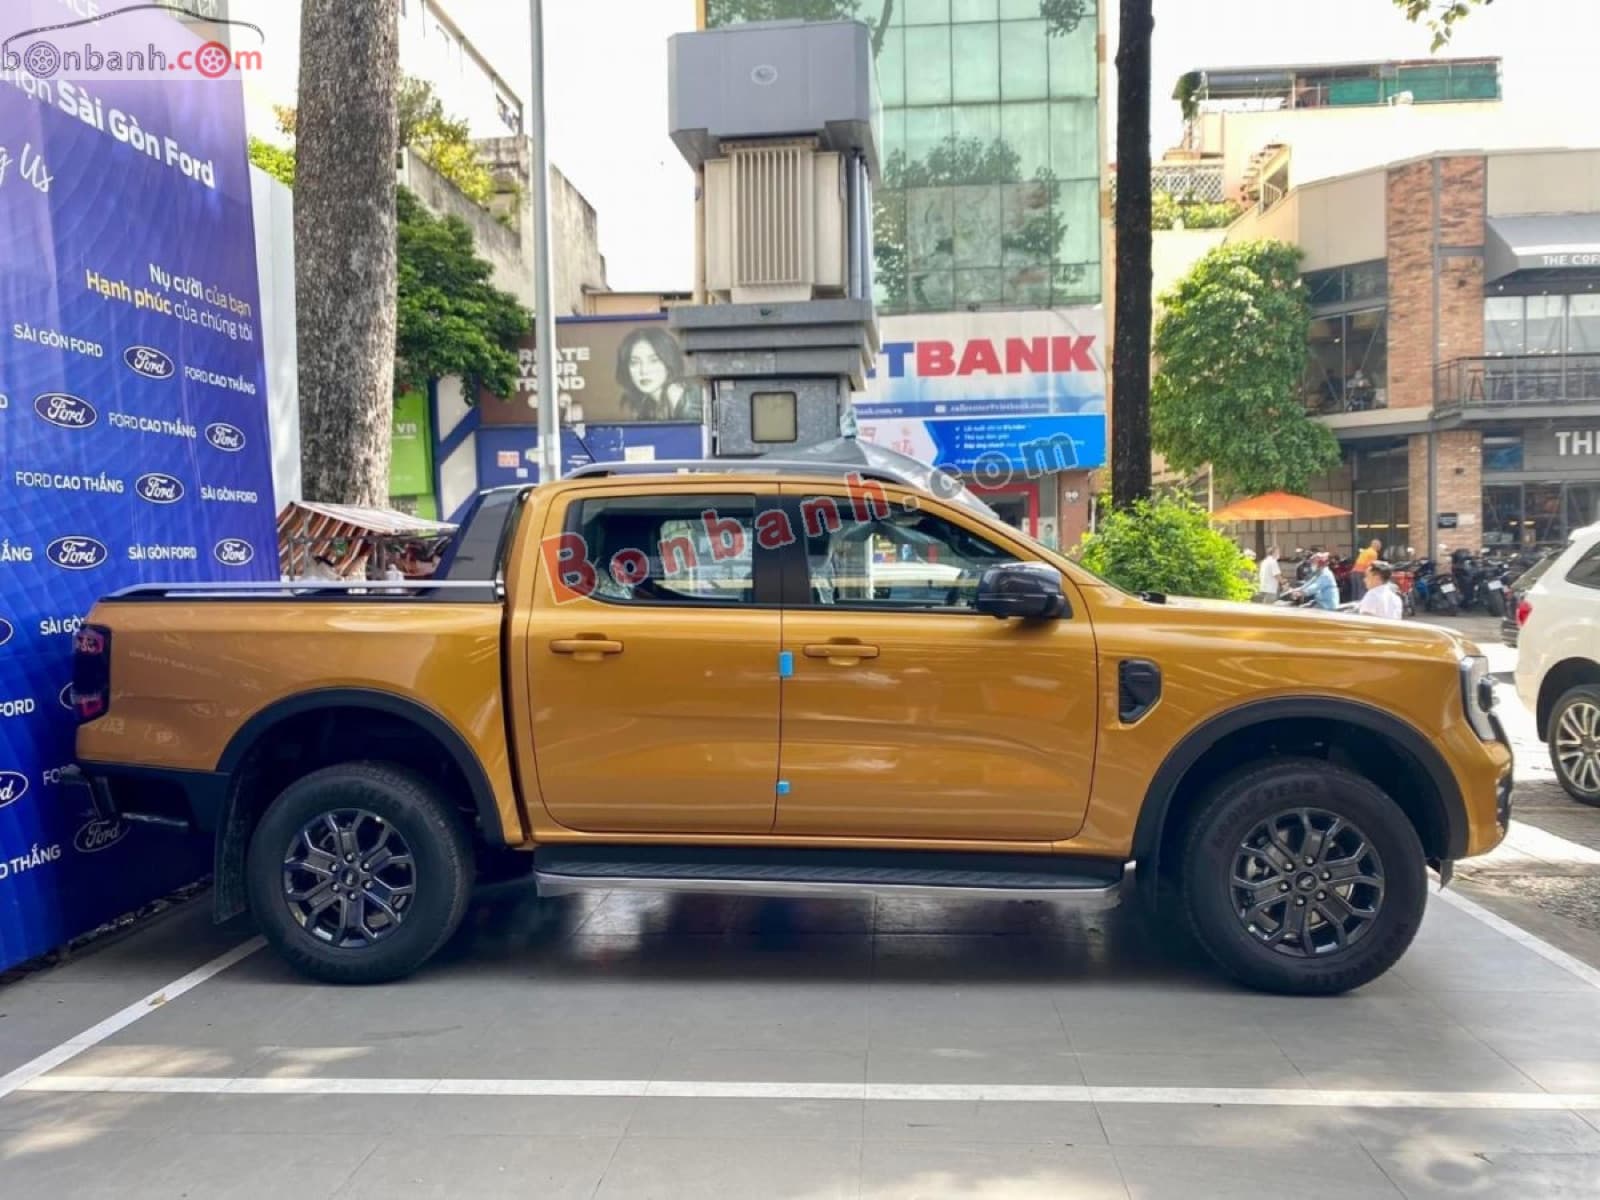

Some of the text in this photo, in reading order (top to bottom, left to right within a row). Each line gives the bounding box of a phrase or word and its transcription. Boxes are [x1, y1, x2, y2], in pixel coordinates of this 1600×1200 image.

[57, 79, 104, 131] Sài
[108, 108, 161, 161] Gòn
[164, 136, 216, 189] Ford
[1543, 255, 1568, 265] THE
[149, 263, 171, 292] Nụ
[205, 285, 230, 306] của
[86, 269, 253, 342] Hạnh phúc của chúng tôi
[14, 321, 104, 358] SÀI GÒN FORD
[134, 349, 167, 375] Ford
[866, 335, 1097, 379] TBANK
[184, 366, 208, 384] FORD
[208, 373, 228, 389] CAO
[47, 396, 86, 425] Ford
[109, 413, 137, 430] FORD
[139, 416, 162, 434] CAO
[213, 426, 239, 448] Ford
[16, 472, 52, 488] FORD
[54, 474, 81, 490] CAO
[144, 477, 176, 500] Ford
[201, 483, 258, 504] SÀI GÒN FORD
[59, 540, 97, 564] Ford
[128, 542, 197, 560] SÀI GÒN FORD
[221, 541, 247, 561] Ford
[40, 615, 84, 636] SÀI GÒ
